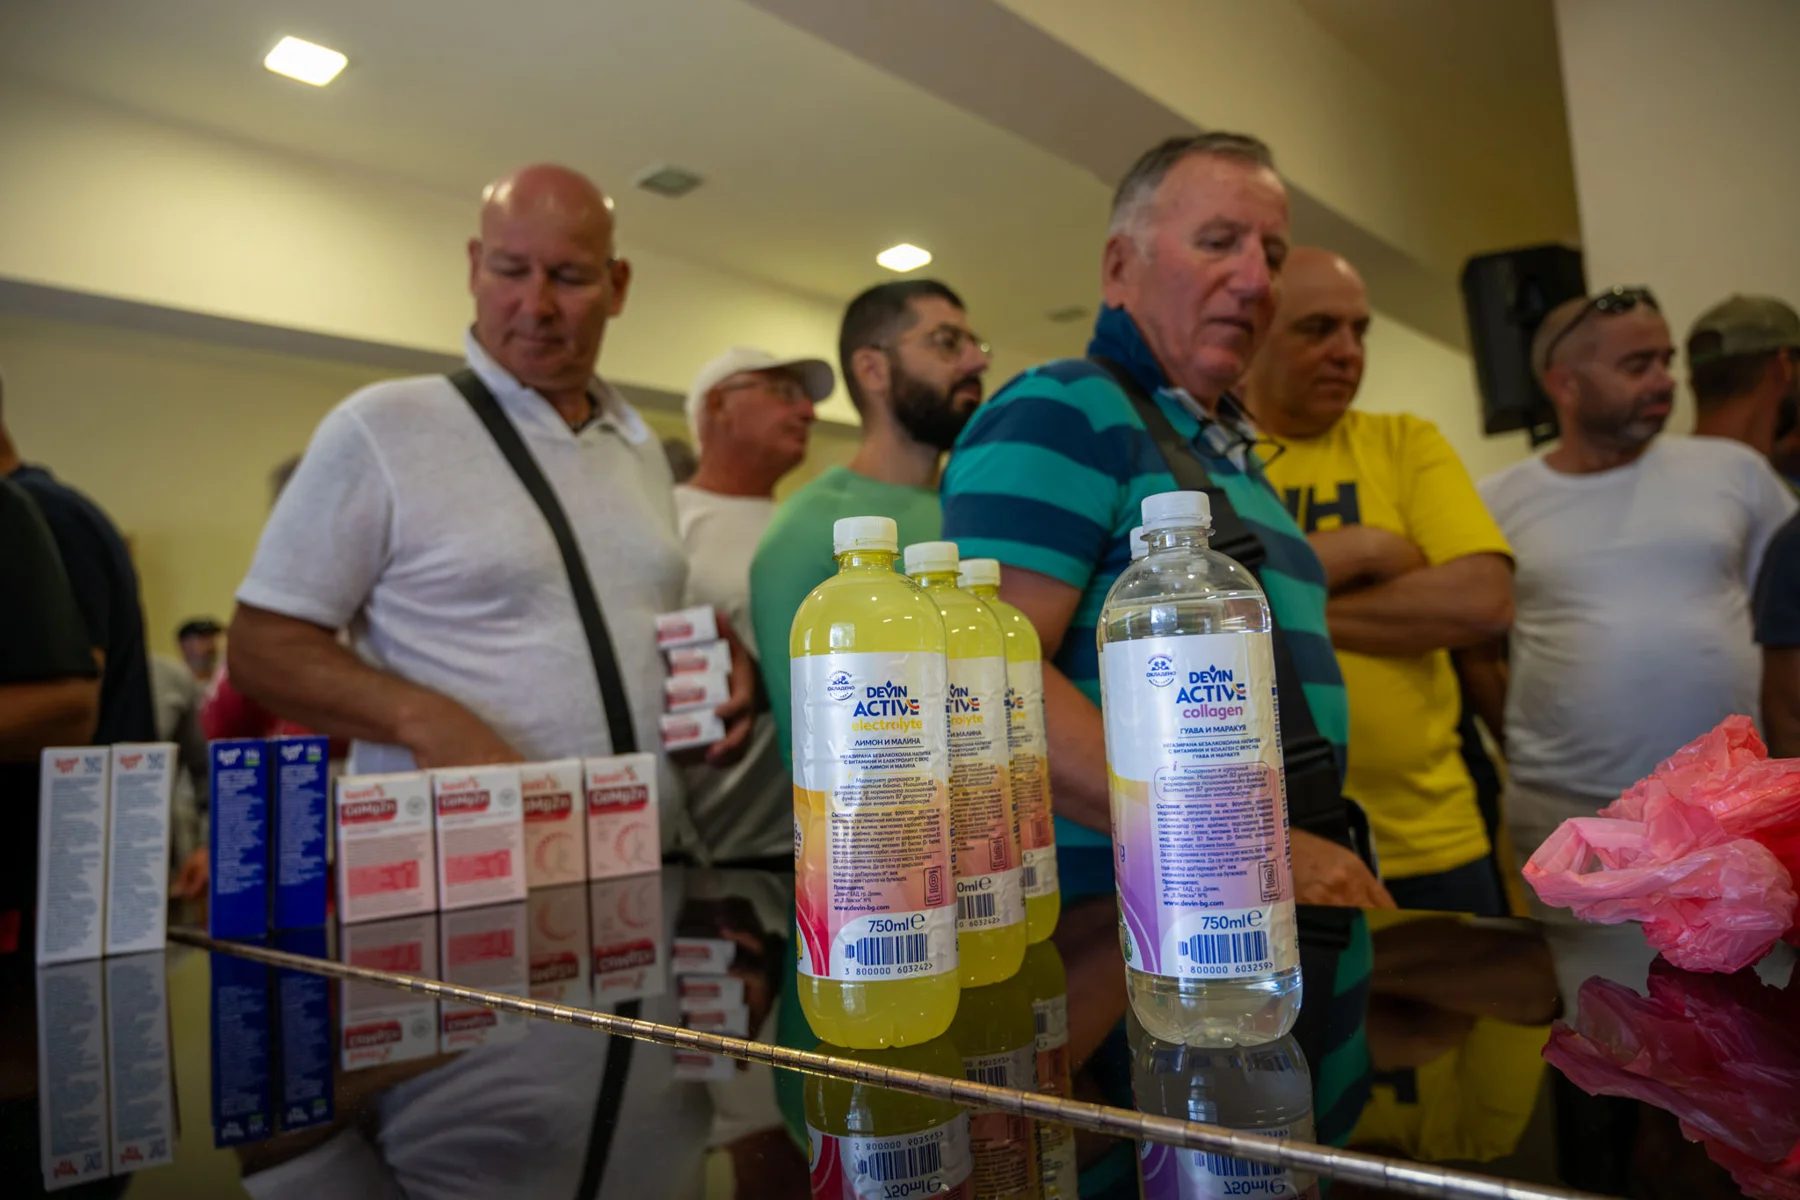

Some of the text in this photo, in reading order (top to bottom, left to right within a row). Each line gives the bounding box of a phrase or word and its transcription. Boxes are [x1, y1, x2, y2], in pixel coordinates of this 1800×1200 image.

[1189, 668, 1233, 684] DEVIN
[867, 684, 908, 698] DEVIN
[1176, 683, 1246, 704] ACTIVE
[853, 699, 920, 717] ACTIVE
[1183, 704, 1243, 720] collagen
[851, 718, 922, 733] electrolyte
[951, 714, 984, 728] rolyte
[1180, 727, 1205, 735] ГУАВА
[1213, 724, 1246, 733] МАРАКУЯ
[855, 739, 883, 747] ЛИМОН
[957, 880, 978, 893] 0ml
[868, 917, 908, 933] 750ml
[1201, 914, 1245, 930] 750ml
[856, 967, 891, 976] 800000
[1190, 966, 1229, 974] 800000
